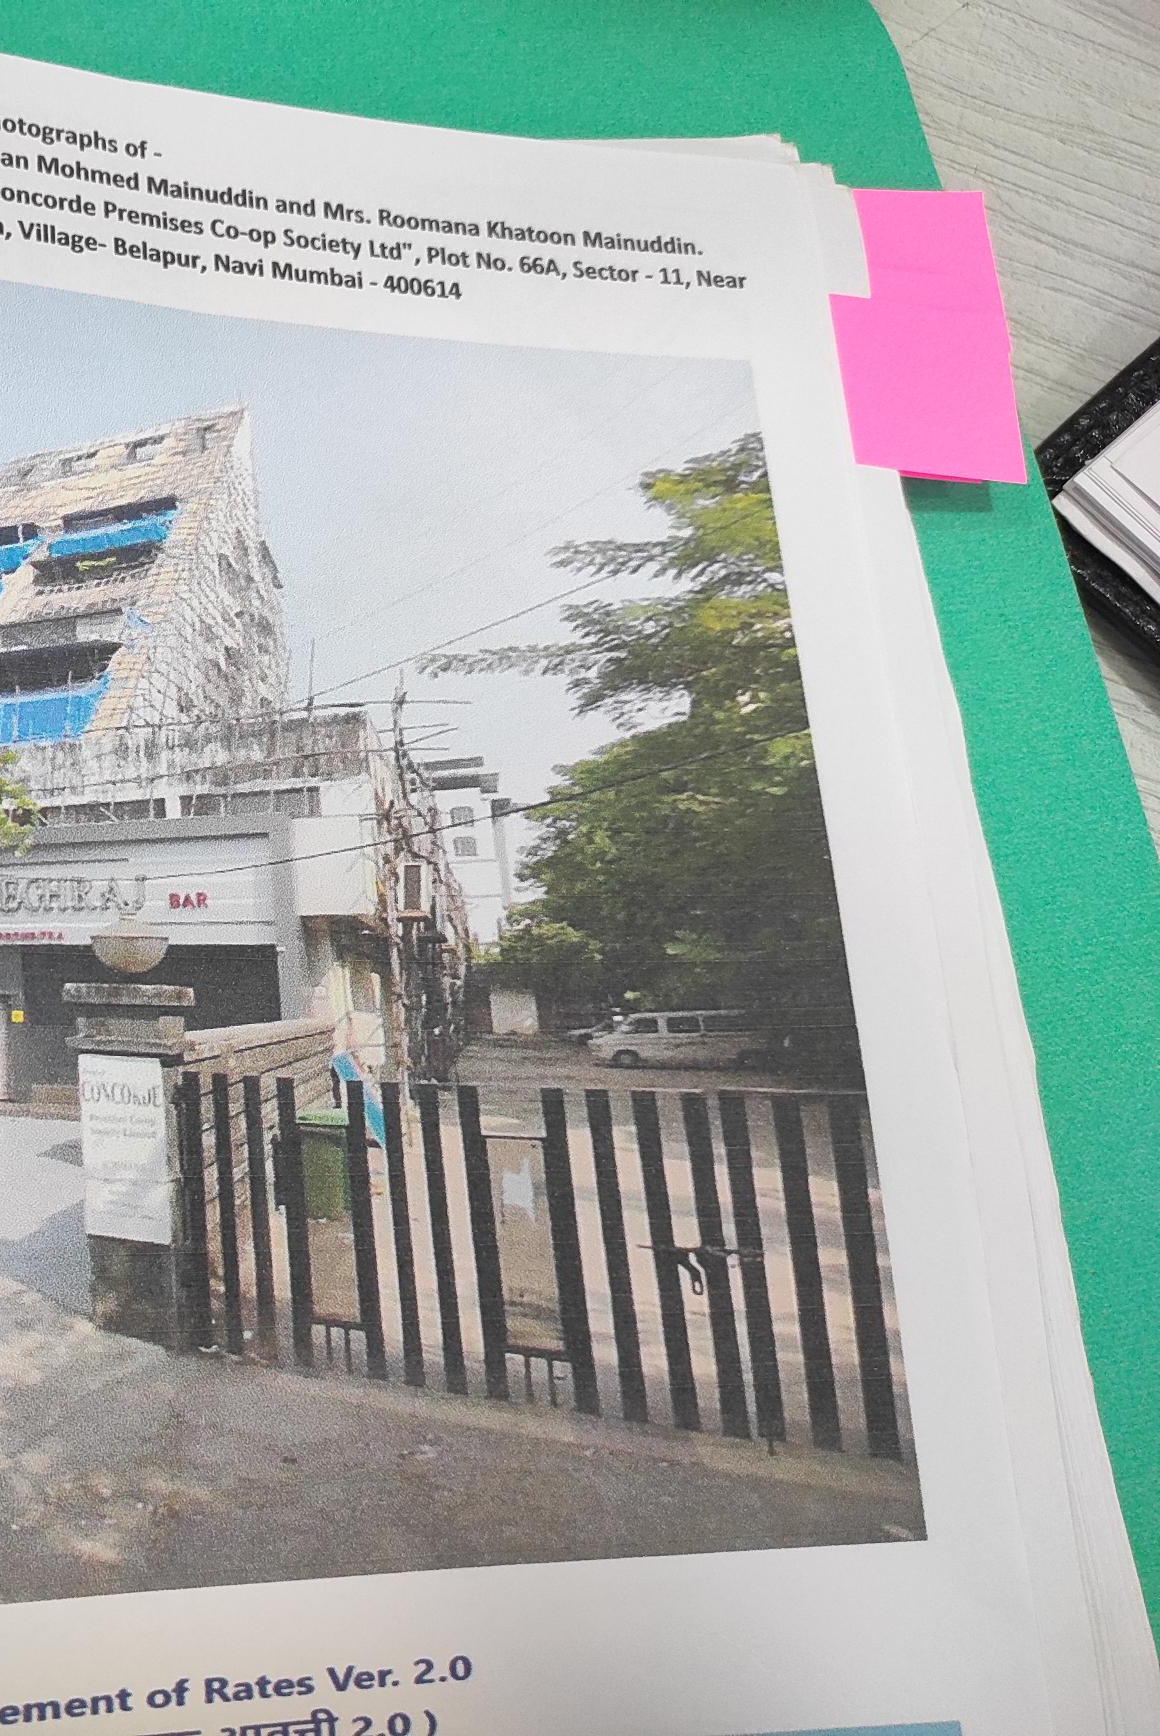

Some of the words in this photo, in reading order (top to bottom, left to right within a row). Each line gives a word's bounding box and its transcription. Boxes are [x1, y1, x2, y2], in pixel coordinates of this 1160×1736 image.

[125, 140, 149, 160] of
[37, 155, 140, 192] Mohmed
[147, 176, 269, 211] Mainuddin
[275, 199, 316, 218] and
[324, 201, 372, 225] Mrs.
[378, 209, 480, 237] Roomana
[487, 220, 576, 247] Khatoon
[583, 231, 704, 256] Mainuddin.
[18, 221, 107, 254] Village-
[114, 237, 208, 274] Belapur,
[214, 254, 265, 278] Navi
[272, 261, 364, 290] Mumbai
[382, 277, 463, 301] 400614
[104, 201, 205, 236] Premises
[211, 219, 277, 250] Co-op
[283, 229, 362, 261] Society
[427, 247, 471, 269] Plot
[476, 252, 514, 272] No.
[519, 256, 568, 281] 66A,
[573, 261, 640, 283] Sector
[659, 268, 691, 287] 11,
[697, 270, 748, 290] Near
[168, 892, 209, 910] BAR
[146, 1677, 189, 1709] of
[204, 1672, 315, 1704] Rates
[327, 1665, 400, 1692] Ver.
[413, 1654, 473, 1685] 2.0
